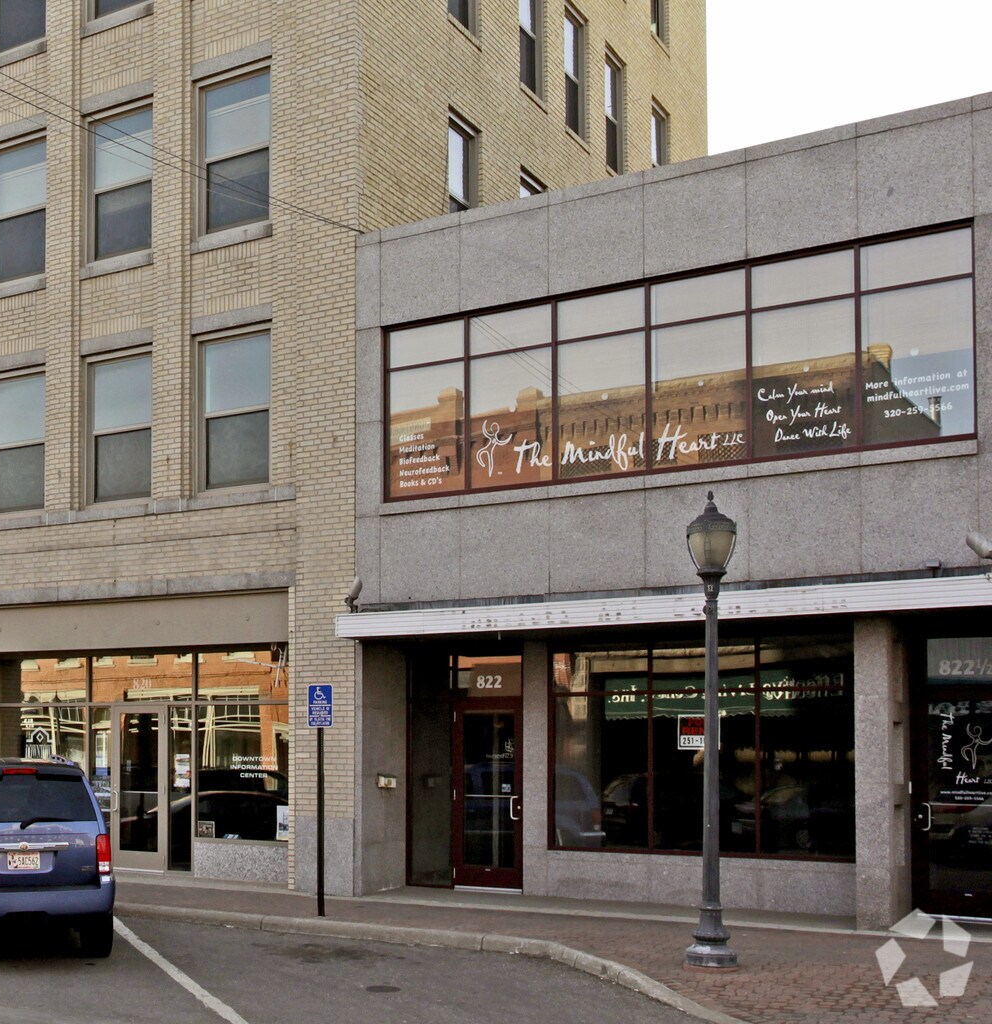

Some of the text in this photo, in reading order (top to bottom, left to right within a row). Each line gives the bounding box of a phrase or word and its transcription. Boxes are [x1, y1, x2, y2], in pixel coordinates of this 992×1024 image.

[865, 368, 968, 390] More information at
[757, 381, 834, 404] Calm Your mind
[867, 383, 969, 402] mindfulheartlive.com
[766, 402, 842, 426] Open Your Heart
[399, 433, 425, 442] Classes
[774, 421, 852, 443] Dance With Life
[399, 443, 436, 453] Meditation
[513, 423, 746, 474] The Mindful Heart LLC
[399, 454, 441, 465] Biofeedback
[399, 465, 450, 477] Neurofeedback
[399, 480, 419, 488] Books
[427, 477, 443, 486] CD's
[132, 678, 152, 690] 820
[476, 675, 502, 689] 822
[687, 717, 705, 727] FO
[939, 712, 955, 730] The
[955, 770, 981, 785] Heart
